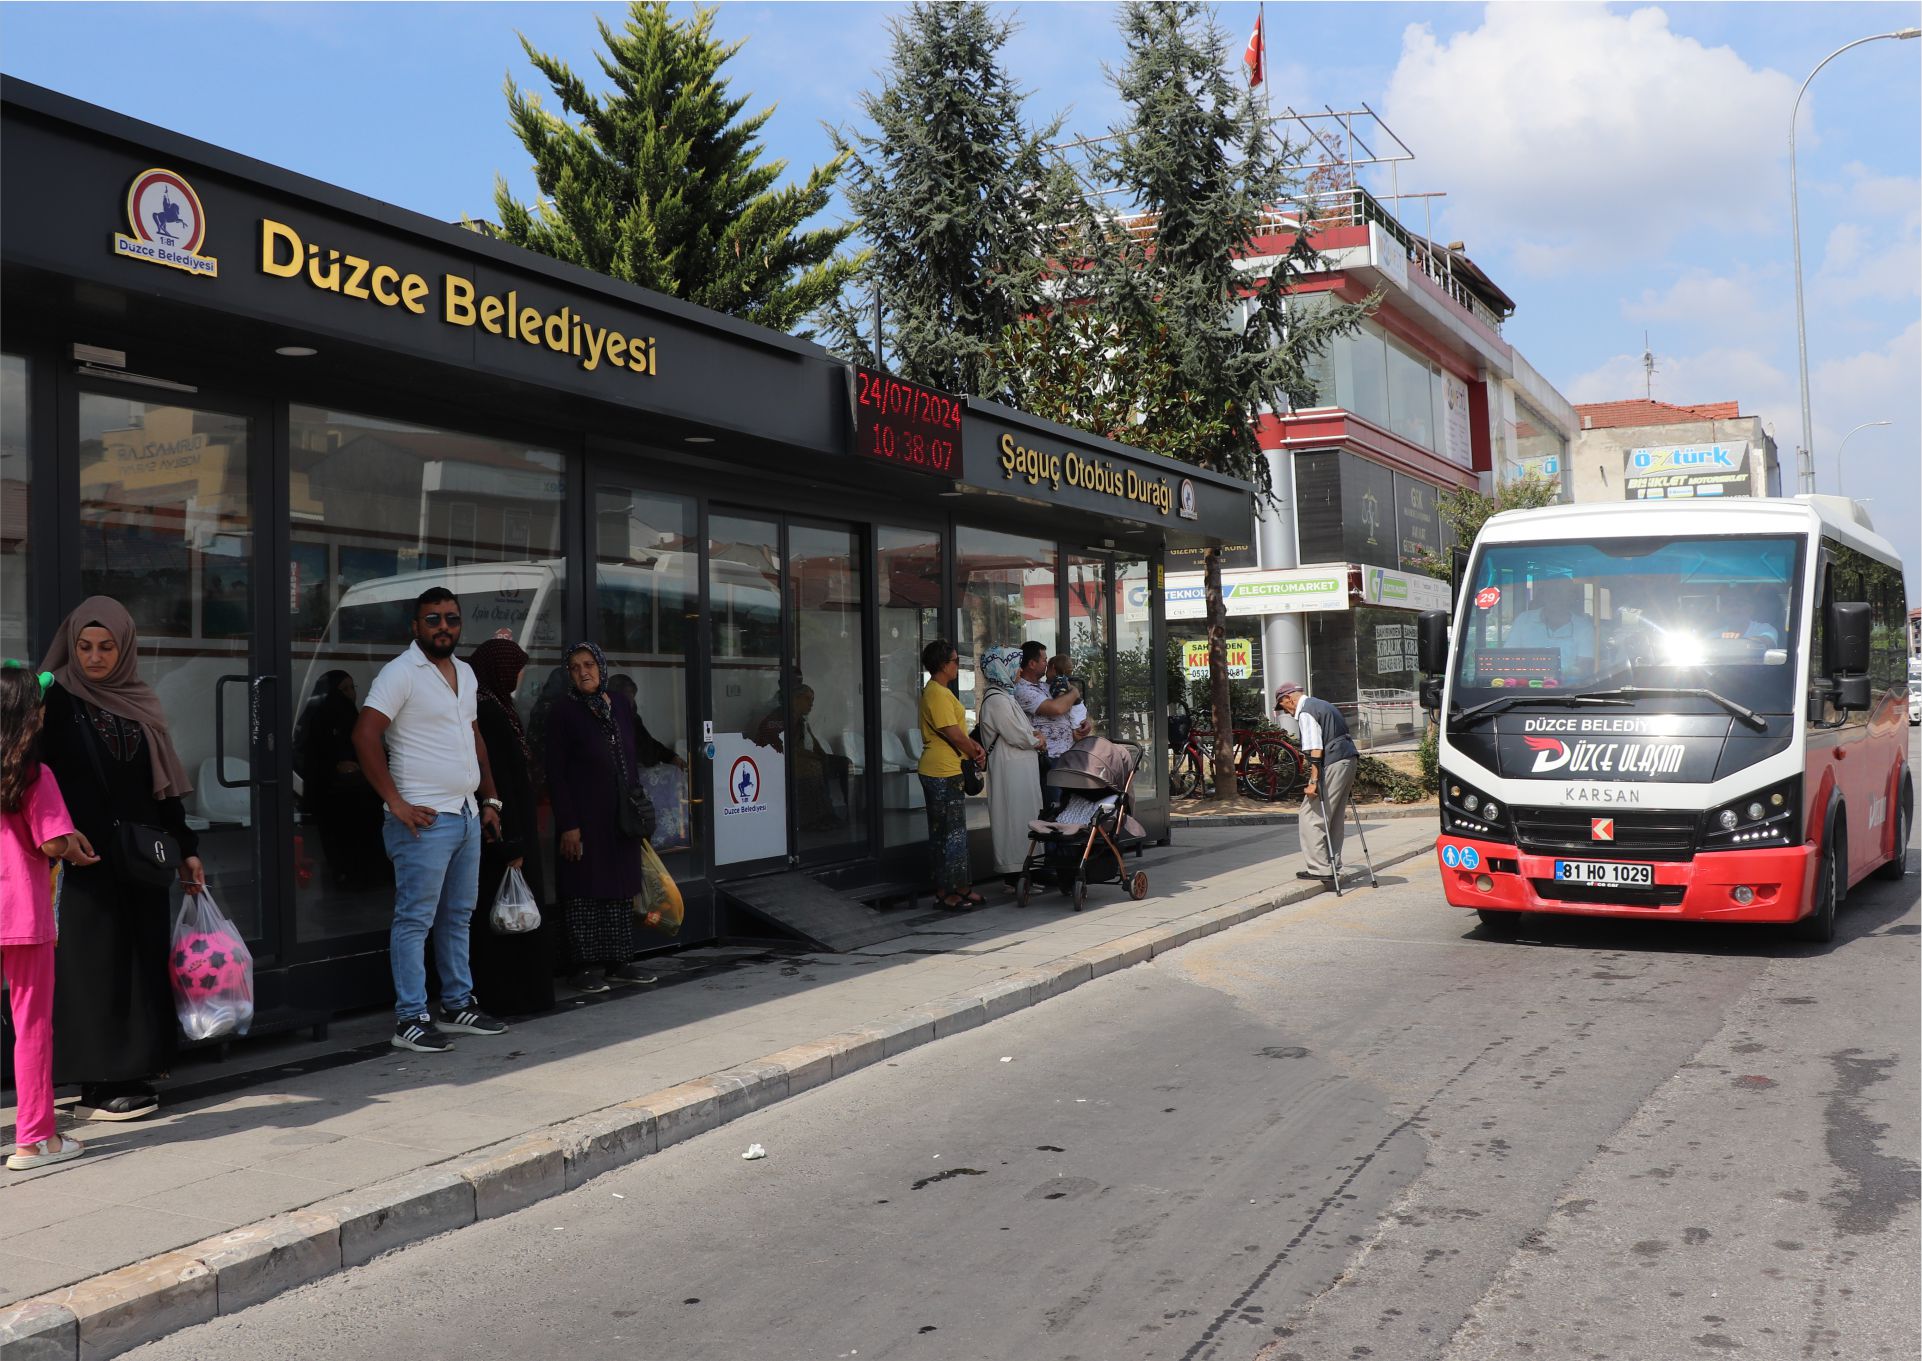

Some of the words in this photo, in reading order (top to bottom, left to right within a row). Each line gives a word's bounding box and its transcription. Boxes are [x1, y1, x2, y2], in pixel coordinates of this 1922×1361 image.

[119, 240, 155, 256] Düzce
[158, 249, 214, 271] Belediyesi
[262, 218, 429, 314] Düzce
[446, 274, 656, 376] Belediyesi
[859, 372, 961, 431] 24/07/2024
[873, 423, 953, 472] 10:38:07
[1001, 434, 1060, 491] Şaguç
[1065, 452, 1124, 497] Otobüs
[1127, 469, 1172, 515] Durağı
[1239, 580, 1336, 596] ELECTROMARKET
[1480, 592, 1496, 604] 29
[1524, 717, 1577, 732] DÜZCE
[1581, 717, 1655, 732] BELEDİY
[1618, 744, 1685, 777] ULAŞIM
[1565, 787, 1640, 803] KARSAN
[1563, 863, 1580, 879] 81
[1613, 865, 1649, 883] 1029
